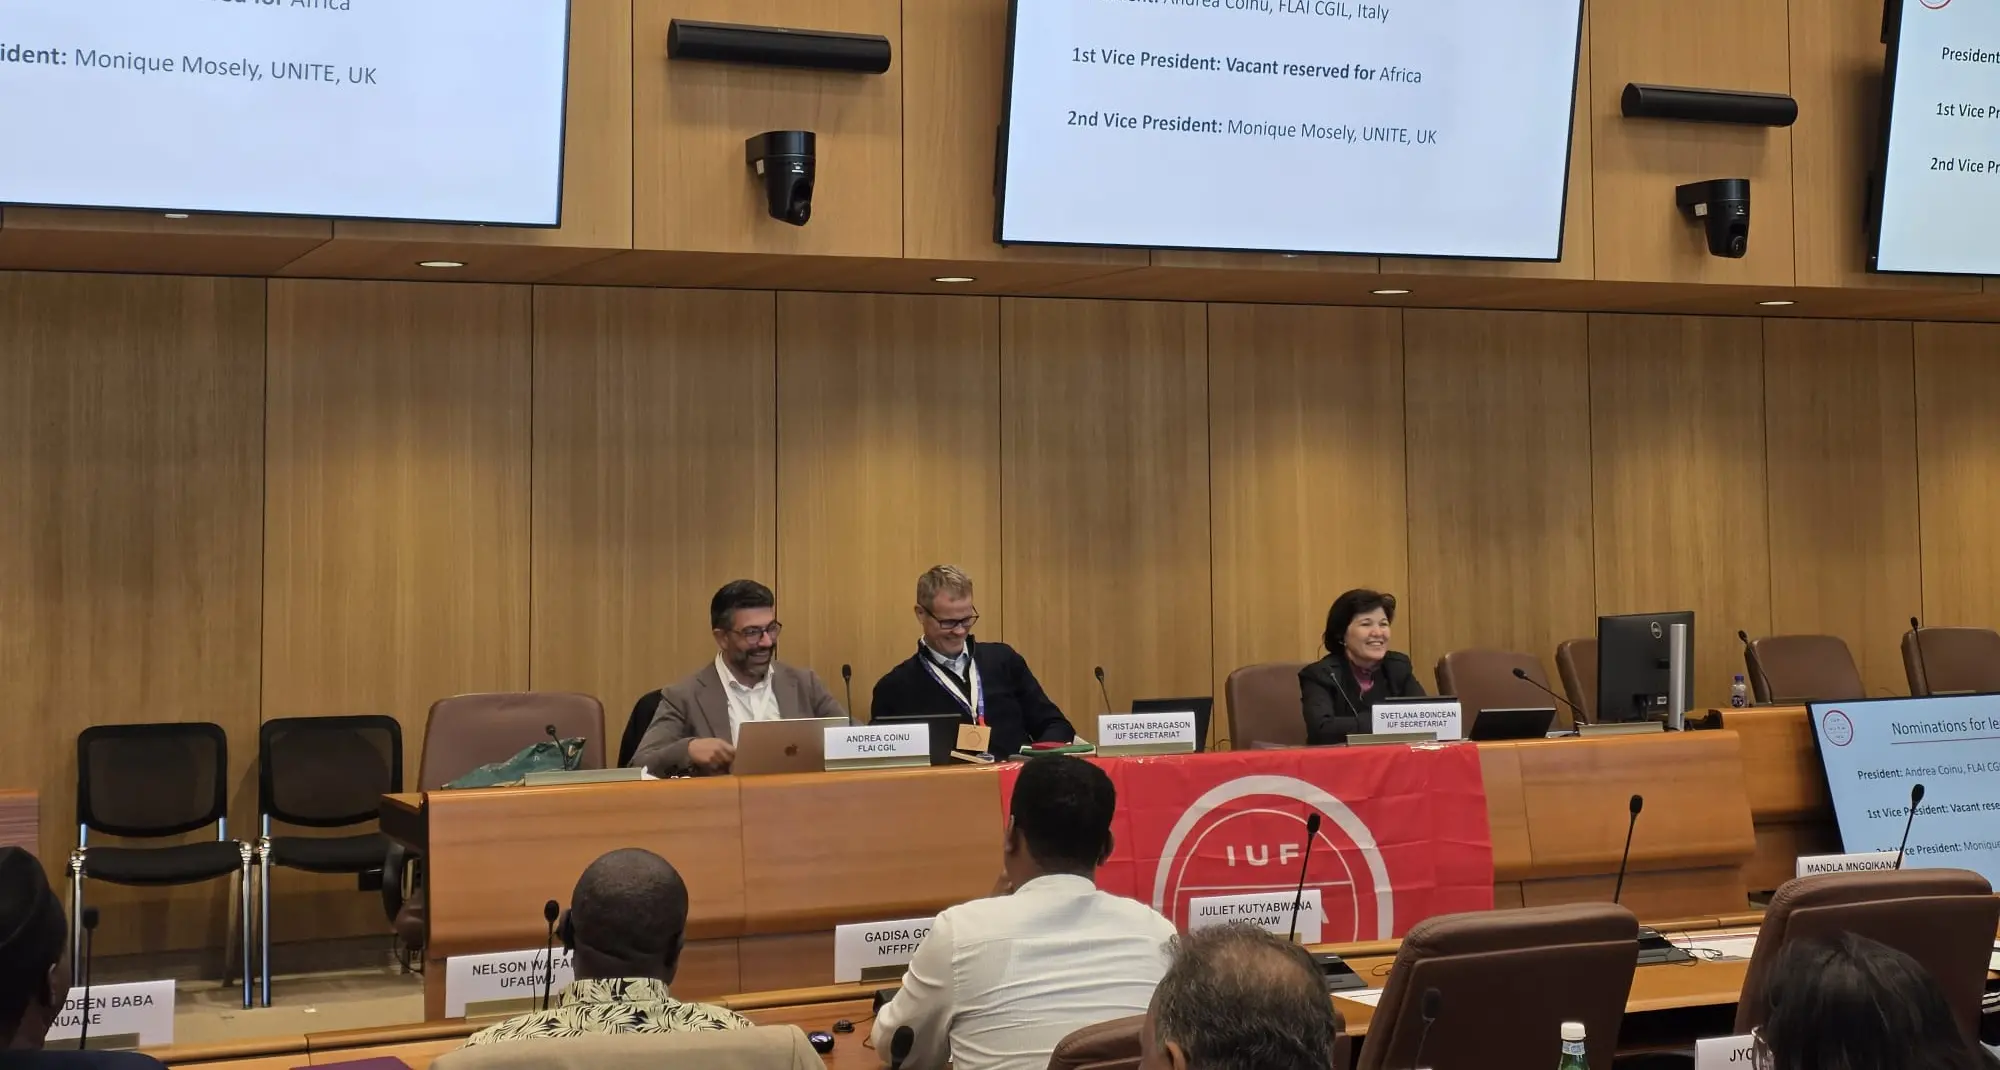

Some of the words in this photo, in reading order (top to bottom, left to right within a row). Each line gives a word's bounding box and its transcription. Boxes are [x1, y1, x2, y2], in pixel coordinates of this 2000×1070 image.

[1280, 0, 1309, 14] FLAI
[1315, 1, 1352, 19] CGIL,
[1358, 4, 1389, 23] Italy
[0, 43, 66, 66] ident:
[75, 48, 174, 74] Monique
[182, 55, 263, 81] Mosely,
[271, 61, 341, 86] UNITE,
[349, 66, 377, 85] UK
[1072, 48, 1096, 64] 1st
[1101, 50, 1136, 66] Vice
[1140, 52, 1222, 72] President:
[1226, 57, 1279, 76] Vacant
[1283, 61, 1350, 80] reserved
[1354, 64, 1376, 80] for
[1379, 66, 1422, 84] Africa
[1936, 102, 1955, 116] 1st
[1959, 104, 1985, 118] Vice
[1067, 110, 1098, 128] 2nd
[1103, 112, 1137, 130] Vice
[1142, 115, 1222, 134] President:
[1227, 120, 1296, 140] Monique
[1301, 124, 1358, 143] Mosely,
[1362, 127, 1411, 146] UNITE,
[1416, 130, 1438, 145] UK
[1930, 158, 1954, 172] 2nd
[1958, 158, 1984, 173] Vice
[1380, 712, 1416, 720] SVETLANA
[1418, 710, 1457, 719] BOINCEAN
[1106, 722, 1145, 730] KRISTJAN
[1147, 721, 1191, 730] BRAGASON
[1387, 720, 1398, 729] IUF
[1400, 719, 1448, 728] SECRETARIAT
[1892, 719, 1968, 736] Nominations
[1970, 718, 1986, 730] for
[846, 734, 882, 743] ANDREA
[883, 733, 910, 742] COINU
[1114, 732, 1126, 740] IUF
[1128, 730, 1180, 740] SECRETARIAT
[877, 743, 896, 752] CGIL
[1858, 770, 1902, 780] President:
[1904, 766, 1936, 777] Andrea
[1938, 765, 1966, 776] Coinu,
[1967, 763, 1986, 772] FLAI
[1987, 762, 2000, 772] CG
[1867, 809, 1880, 819] 1st
[1882, 807, 1902, 818] Vice
[1950, 803, 1980, 813] Vacant
[1226, 843, 1300, 867] IUF
[1916, 842, 1962, 855] President:
[1807, 862, 1844, 873] MANDLA
[1846, 860, 1898, 872] MNGQIKANA
[1200, 904, 1236, 917] JULIET
[1238, 901, 1312, 915] KUTYABWANA
[864, 930, 910, 942] GADISA
[472, 962, 526, 976] NELSON
[531, 958, 573, 971] WAFA
[112, 994, 153, 1008] BABA
